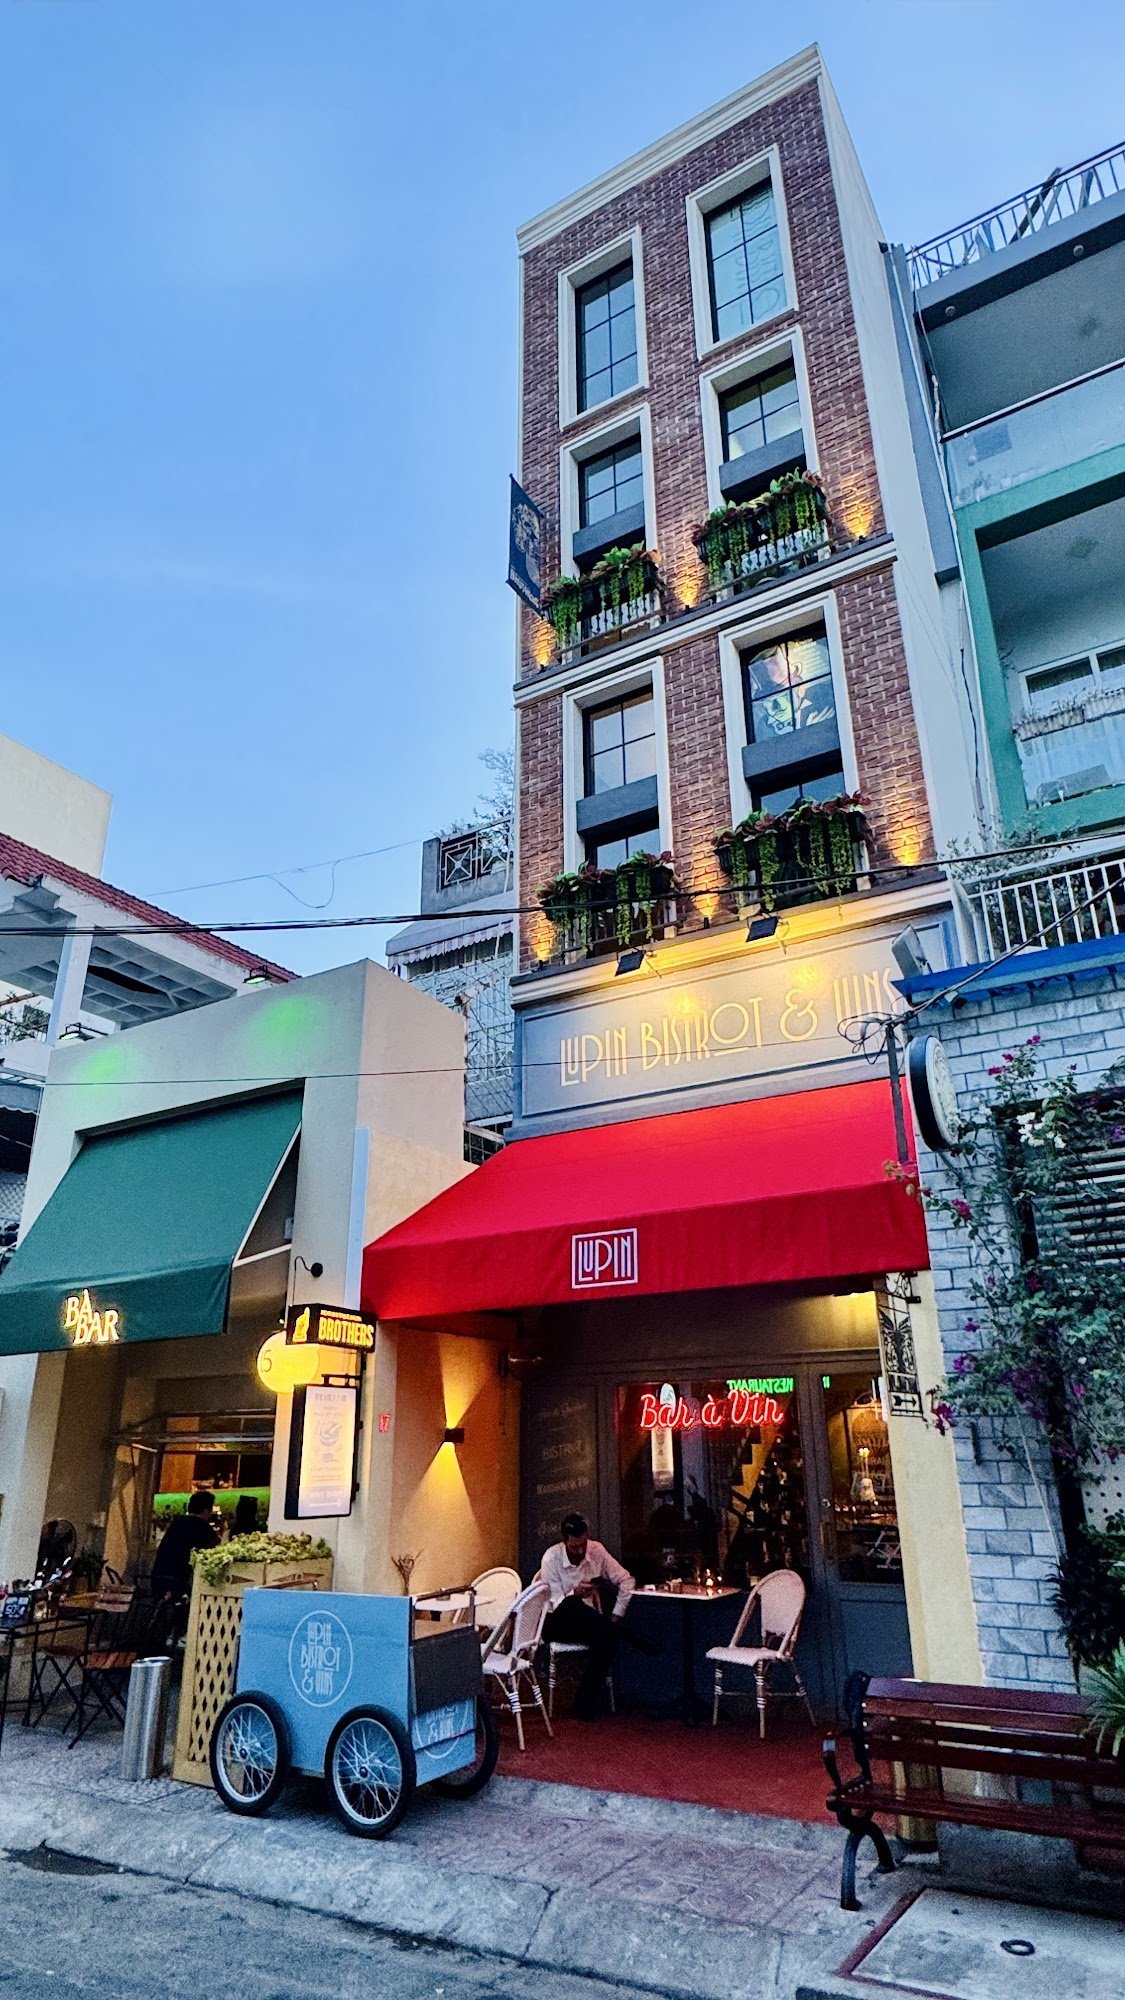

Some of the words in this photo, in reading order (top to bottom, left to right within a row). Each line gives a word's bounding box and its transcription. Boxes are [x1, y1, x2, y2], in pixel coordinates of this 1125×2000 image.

[560, 1026, 628, 1087] LUPIN
[640, 996, 763, 1072] BISTROT
[780, 988, 818, 1042] &
[578, 1235, 632, 1283] LUPIN
[64, 1288, 93, 1329] BA
[73, 1309, 120, 1345] BAR
[318, 1315, 375, 1348] BROTHERS
[639, 1393, 695, 1428] Bar
[701, 1393, 723, 1425] à
[727, 1389, 785, 1424] Vin
